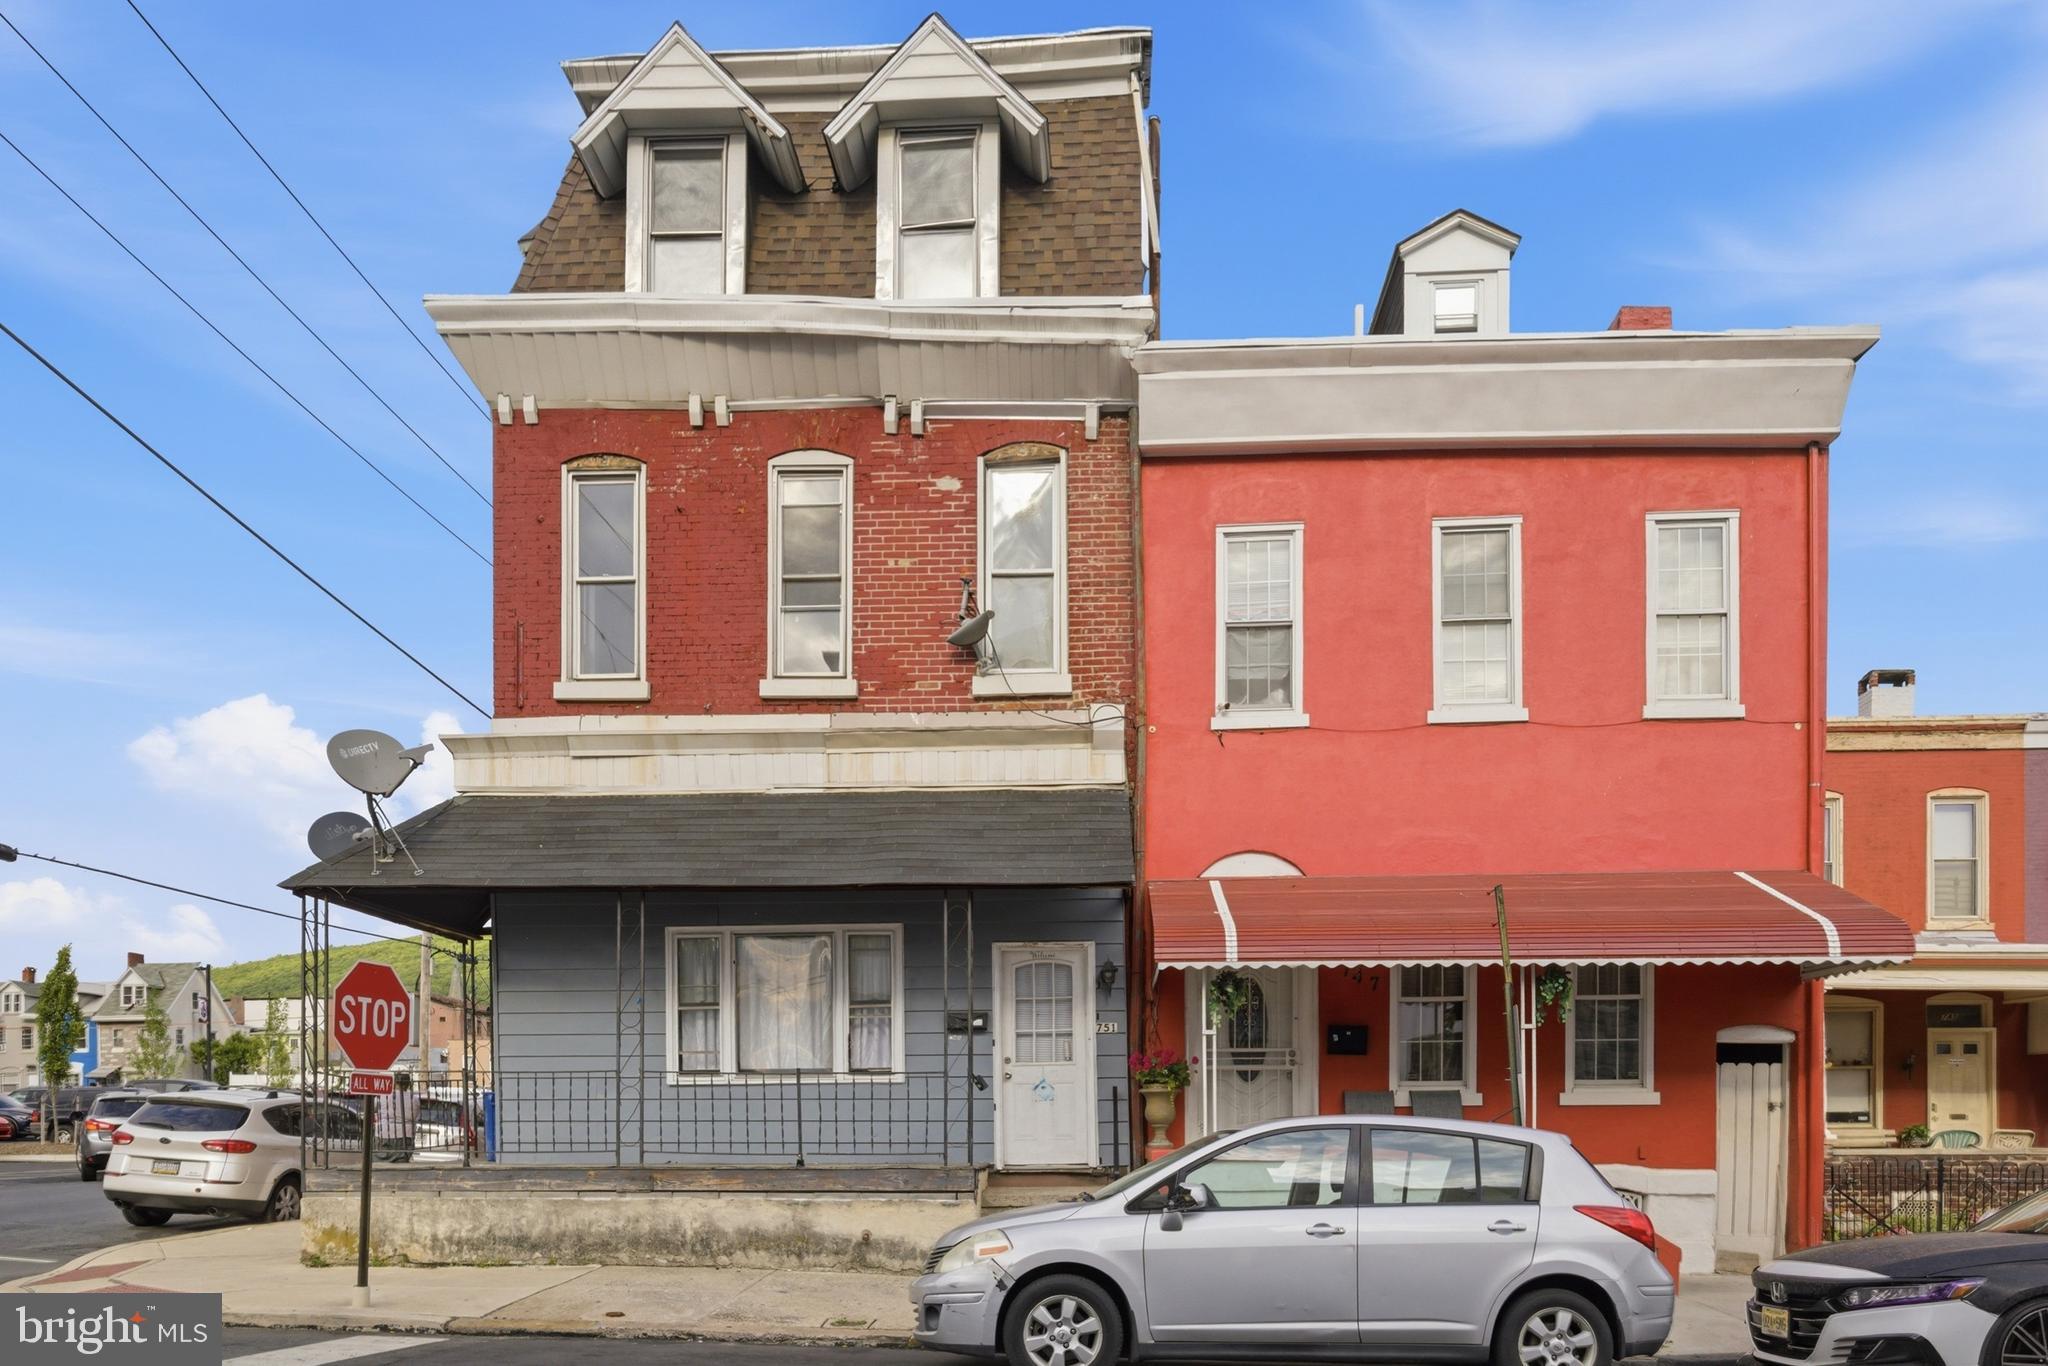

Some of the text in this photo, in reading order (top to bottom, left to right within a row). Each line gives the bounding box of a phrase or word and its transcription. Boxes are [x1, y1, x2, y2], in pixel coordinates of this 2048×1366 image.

[347, 741, 379, 757] DIRECTV
[339, 994, 406, 1038] STOP
[1096, 1023, 1115, 1033] 751
[353, 1077, 391, 1091] ALL WAY
